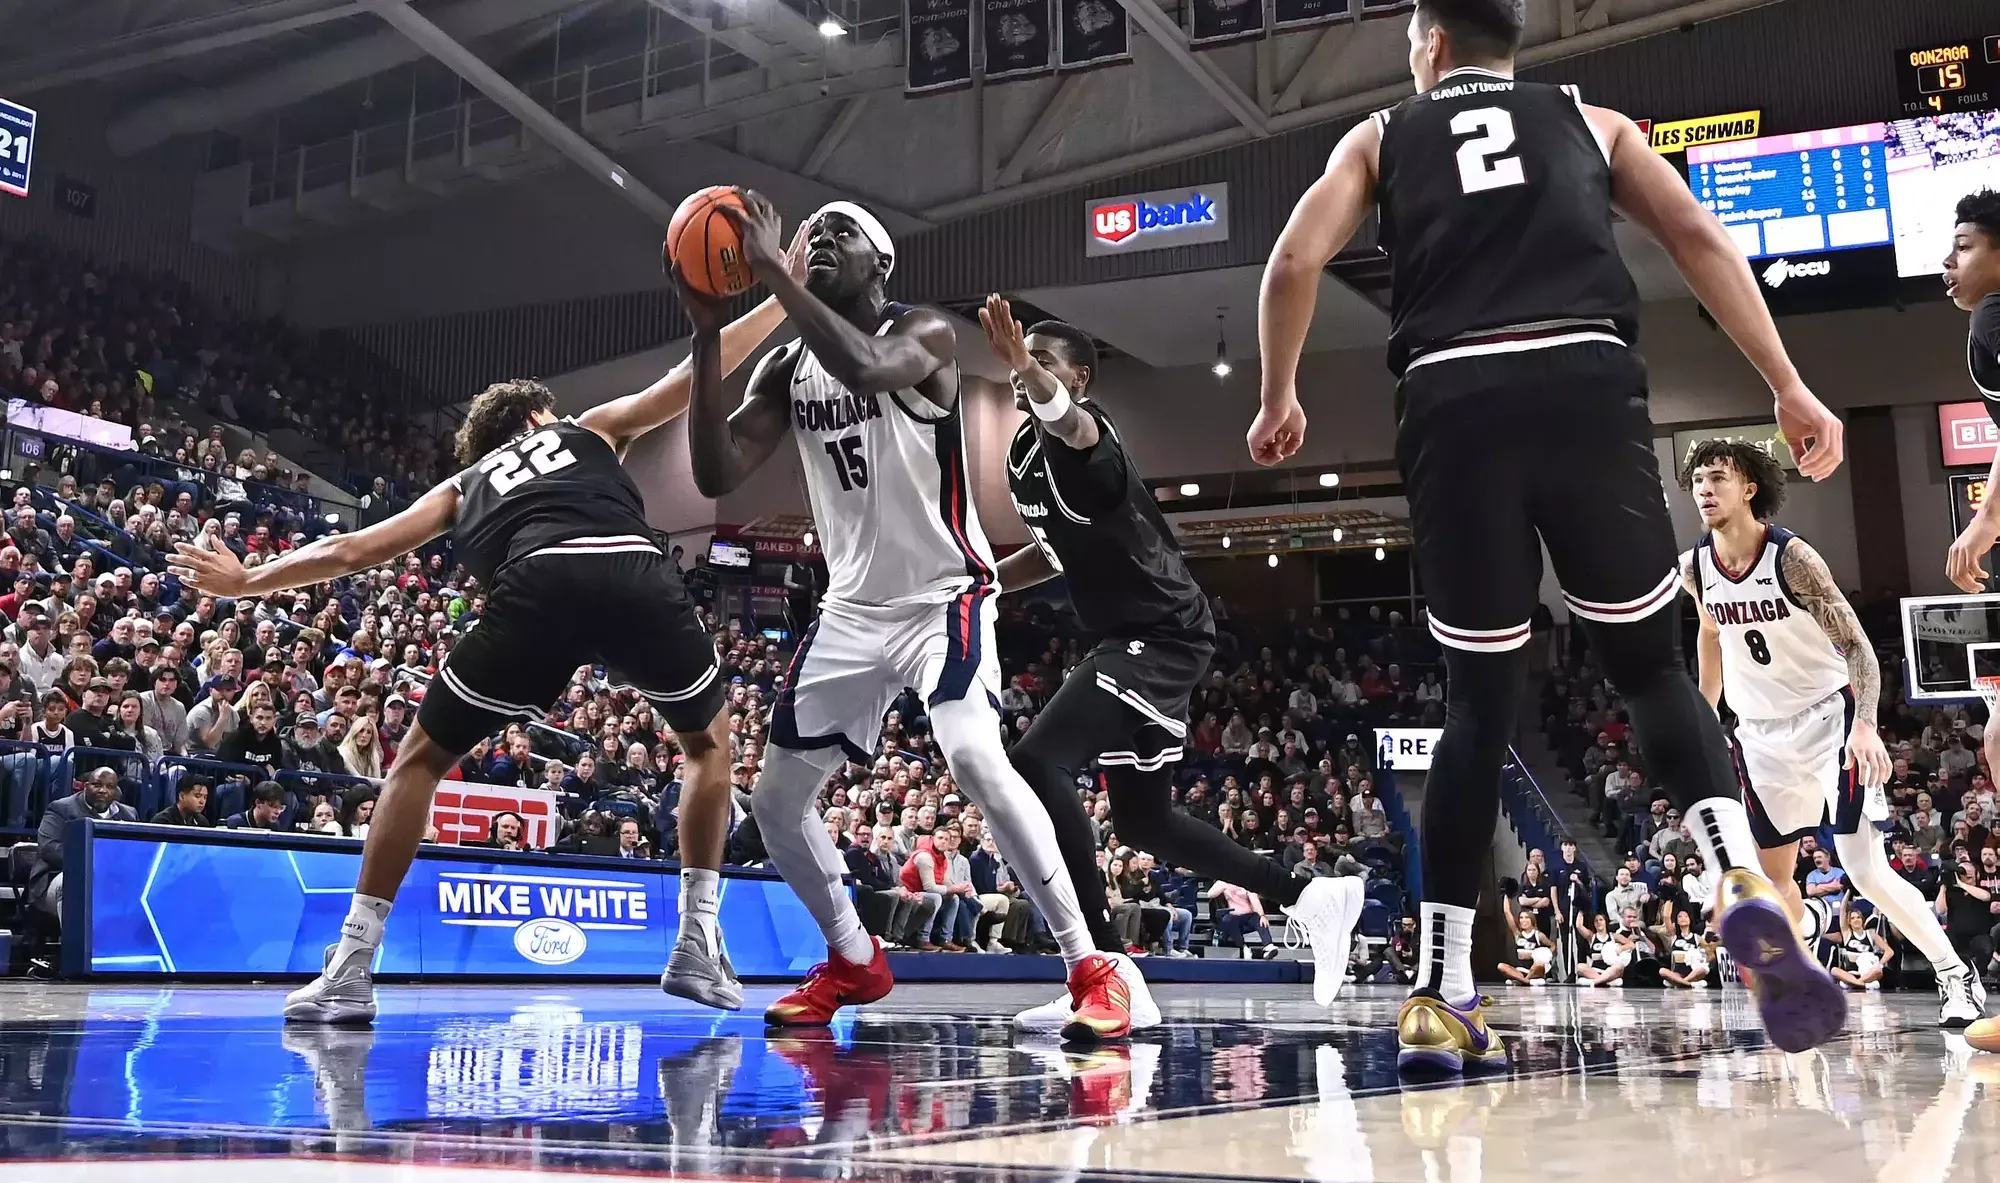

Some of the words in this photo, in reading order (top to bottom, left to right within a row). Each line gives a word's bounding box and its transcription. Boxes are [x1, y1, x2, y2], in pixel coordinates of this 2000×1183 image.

[1909, 45, 1969, 67] GONZAGA
[1938, 64, 1962, 88] 15
[1431, 81, 1514, 101] GAVALYUGOV
[1928, 95, 1942, 111] 4
[1957, 92, 1989, 105] FOULS
[0, 127, 29, 164] 21
[1654, 129, 1681, 147] LES
[1684, 118, 1755, 143] SCHWAB
[1449, 106, 1526, 195] 2
[1096, 210, 1132, 234] us
[1138, 192, 1214, 229] bank
[794, 392, 882, 431] GONZAGA
[21, 442, 39, 456] 106
[479, 430, 577, 497] 22
[824, 435, 868, 491] 15
[755, 541, 793, 553] BAKED
[1706, 598, 1790, 626] GONZAGA
[1744, 629, 1771, 666] 8
[438, 881, 531, 915] MIKE
[539, 886, 648, 920] WHITE
[530, 925, 571, 955] Ford
